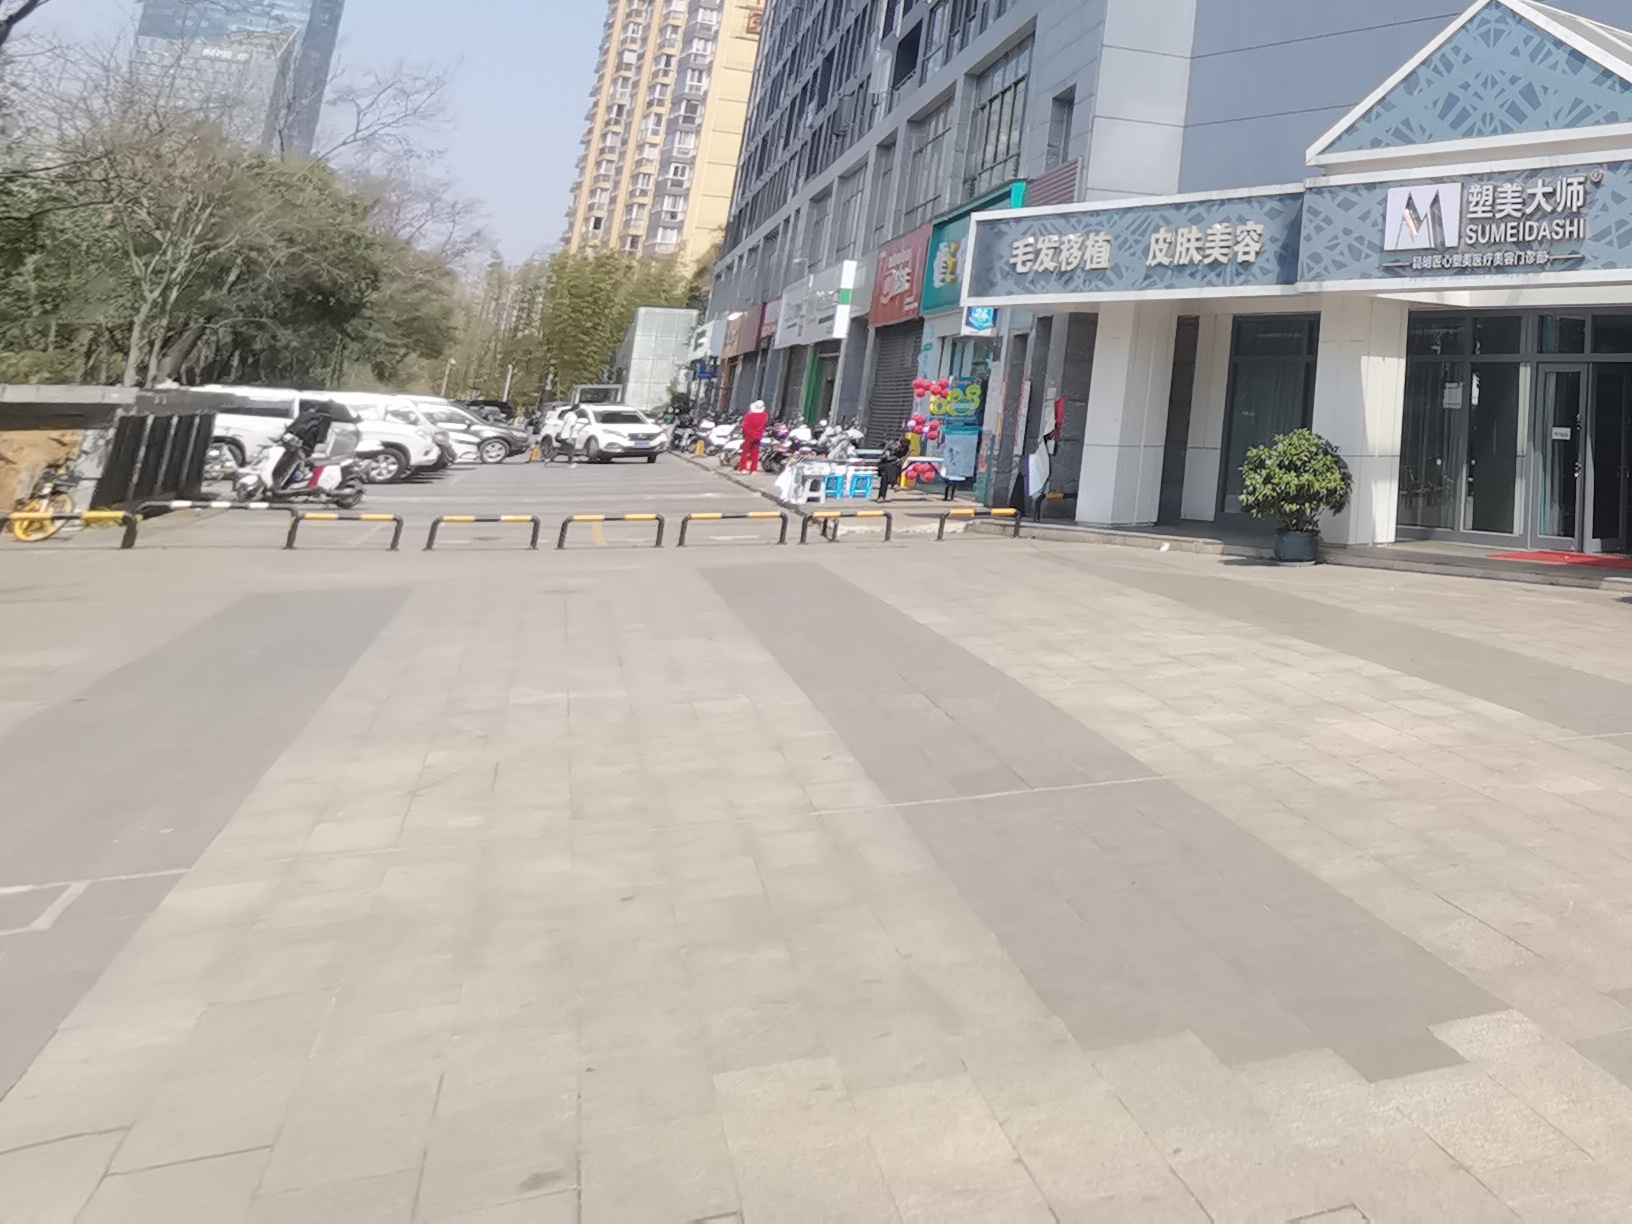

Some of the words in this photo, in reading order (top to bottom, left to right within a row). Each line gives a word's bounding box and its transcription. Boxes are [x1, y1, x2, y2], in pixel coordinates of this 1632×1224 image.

[1466, 176, 1586, 219] 塑美大师
[1009, 231, 1112, 274] 毛发移植
[1145, 221, 1265, 267] 皮肤美容
[1465, 217, 1586, 245] SUMEIDASHI
[1412, 250, 1550, 270] 昆明匠心塑美医疗美容门诊部
